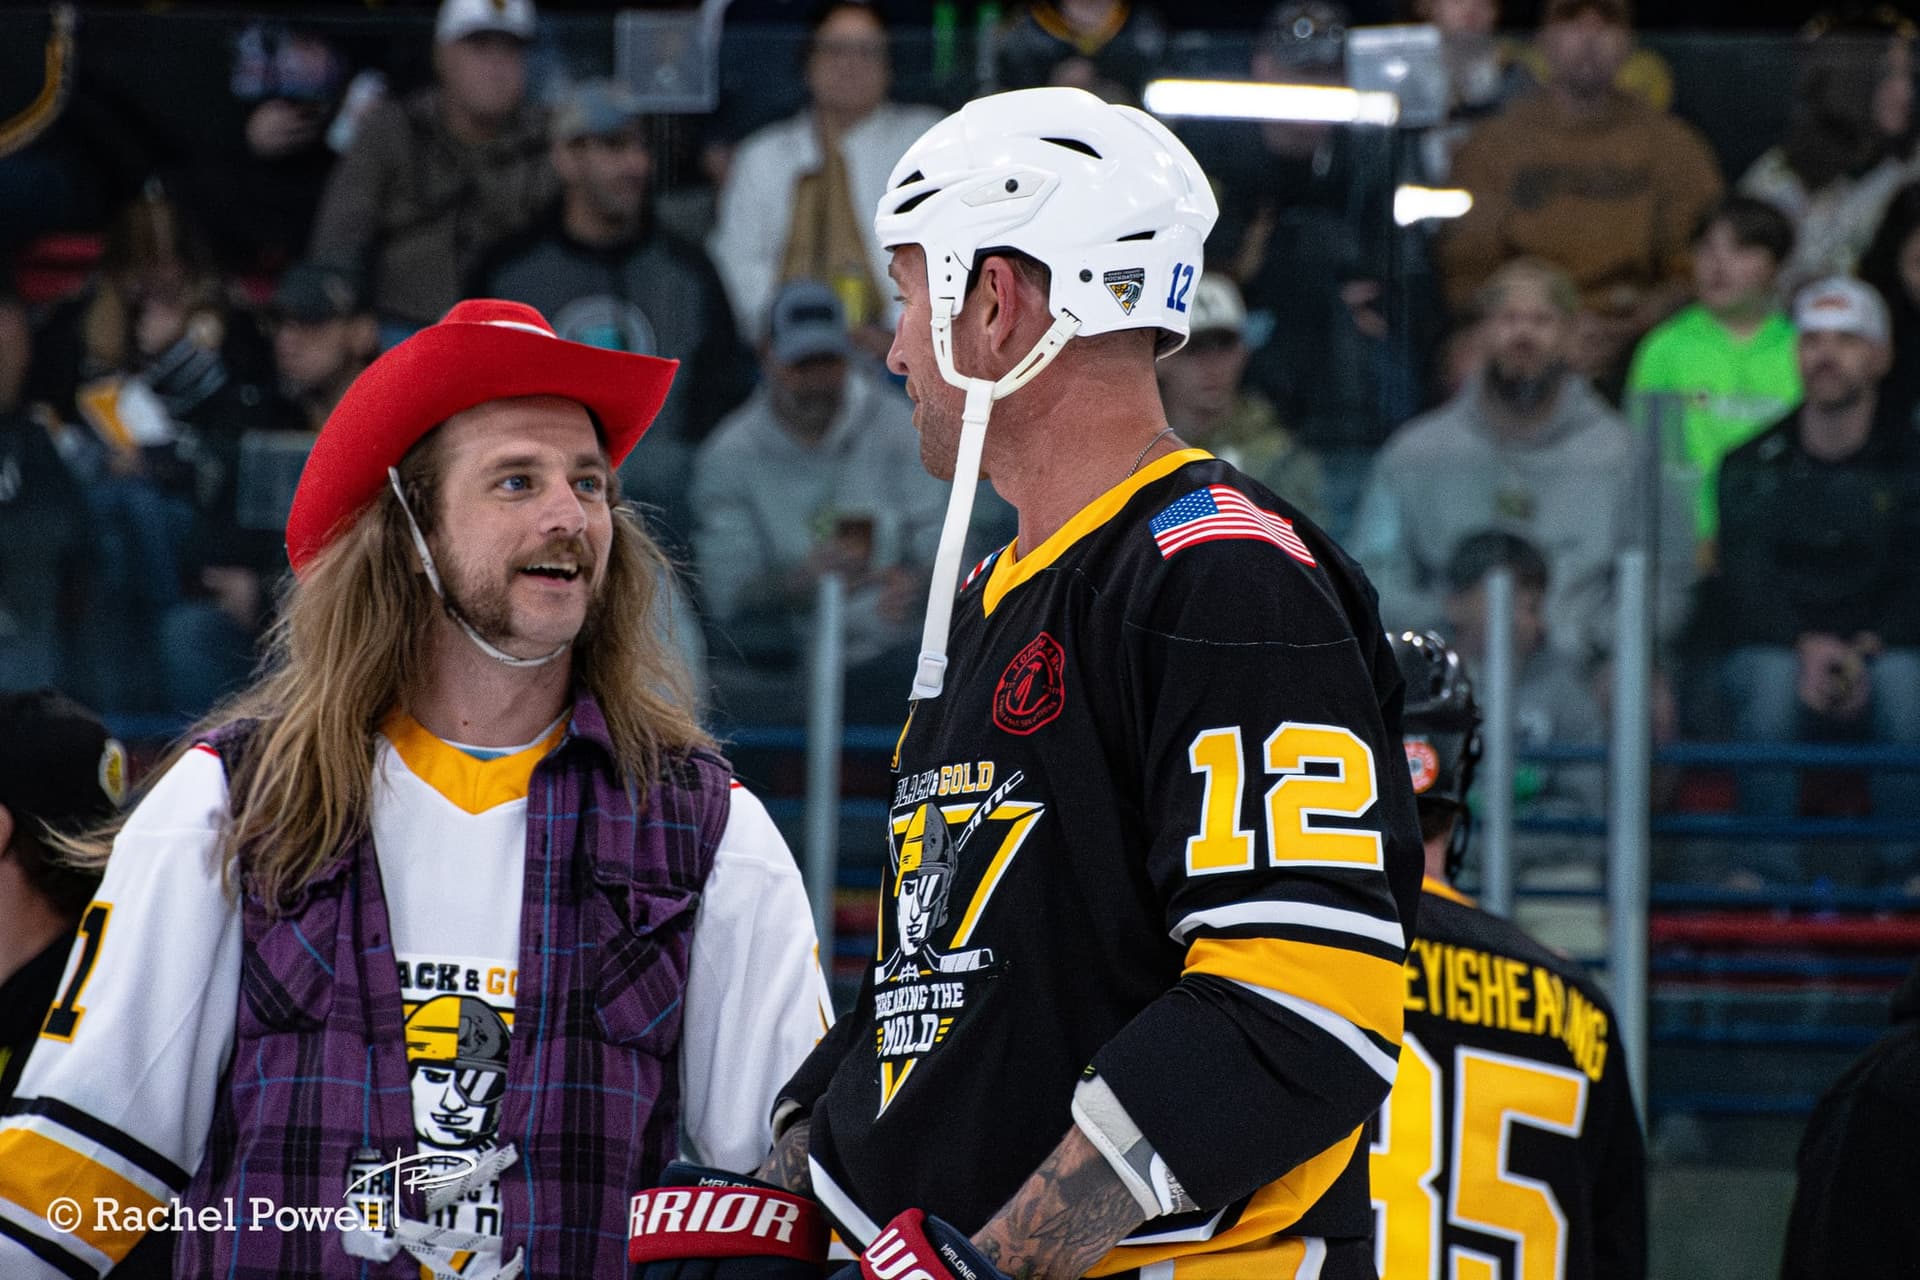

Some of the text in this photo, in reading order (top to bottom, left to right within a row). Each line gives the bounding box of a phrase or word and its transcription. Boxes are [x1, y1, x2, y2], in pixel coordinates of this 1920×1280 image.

[1166, 262, 1194, 313] 12
[937, 761, 995, 796] GOLD
[1185, 721, 1384, 877] 12
[397, 961, 460, 992] ACK
[930, 982, 965, 1009] THE
[877, 1013, 939, 1058] MOLD
[628, 1190, 800, 1244] RRIOR
[940, 1243, 977, 1280] MALONE
